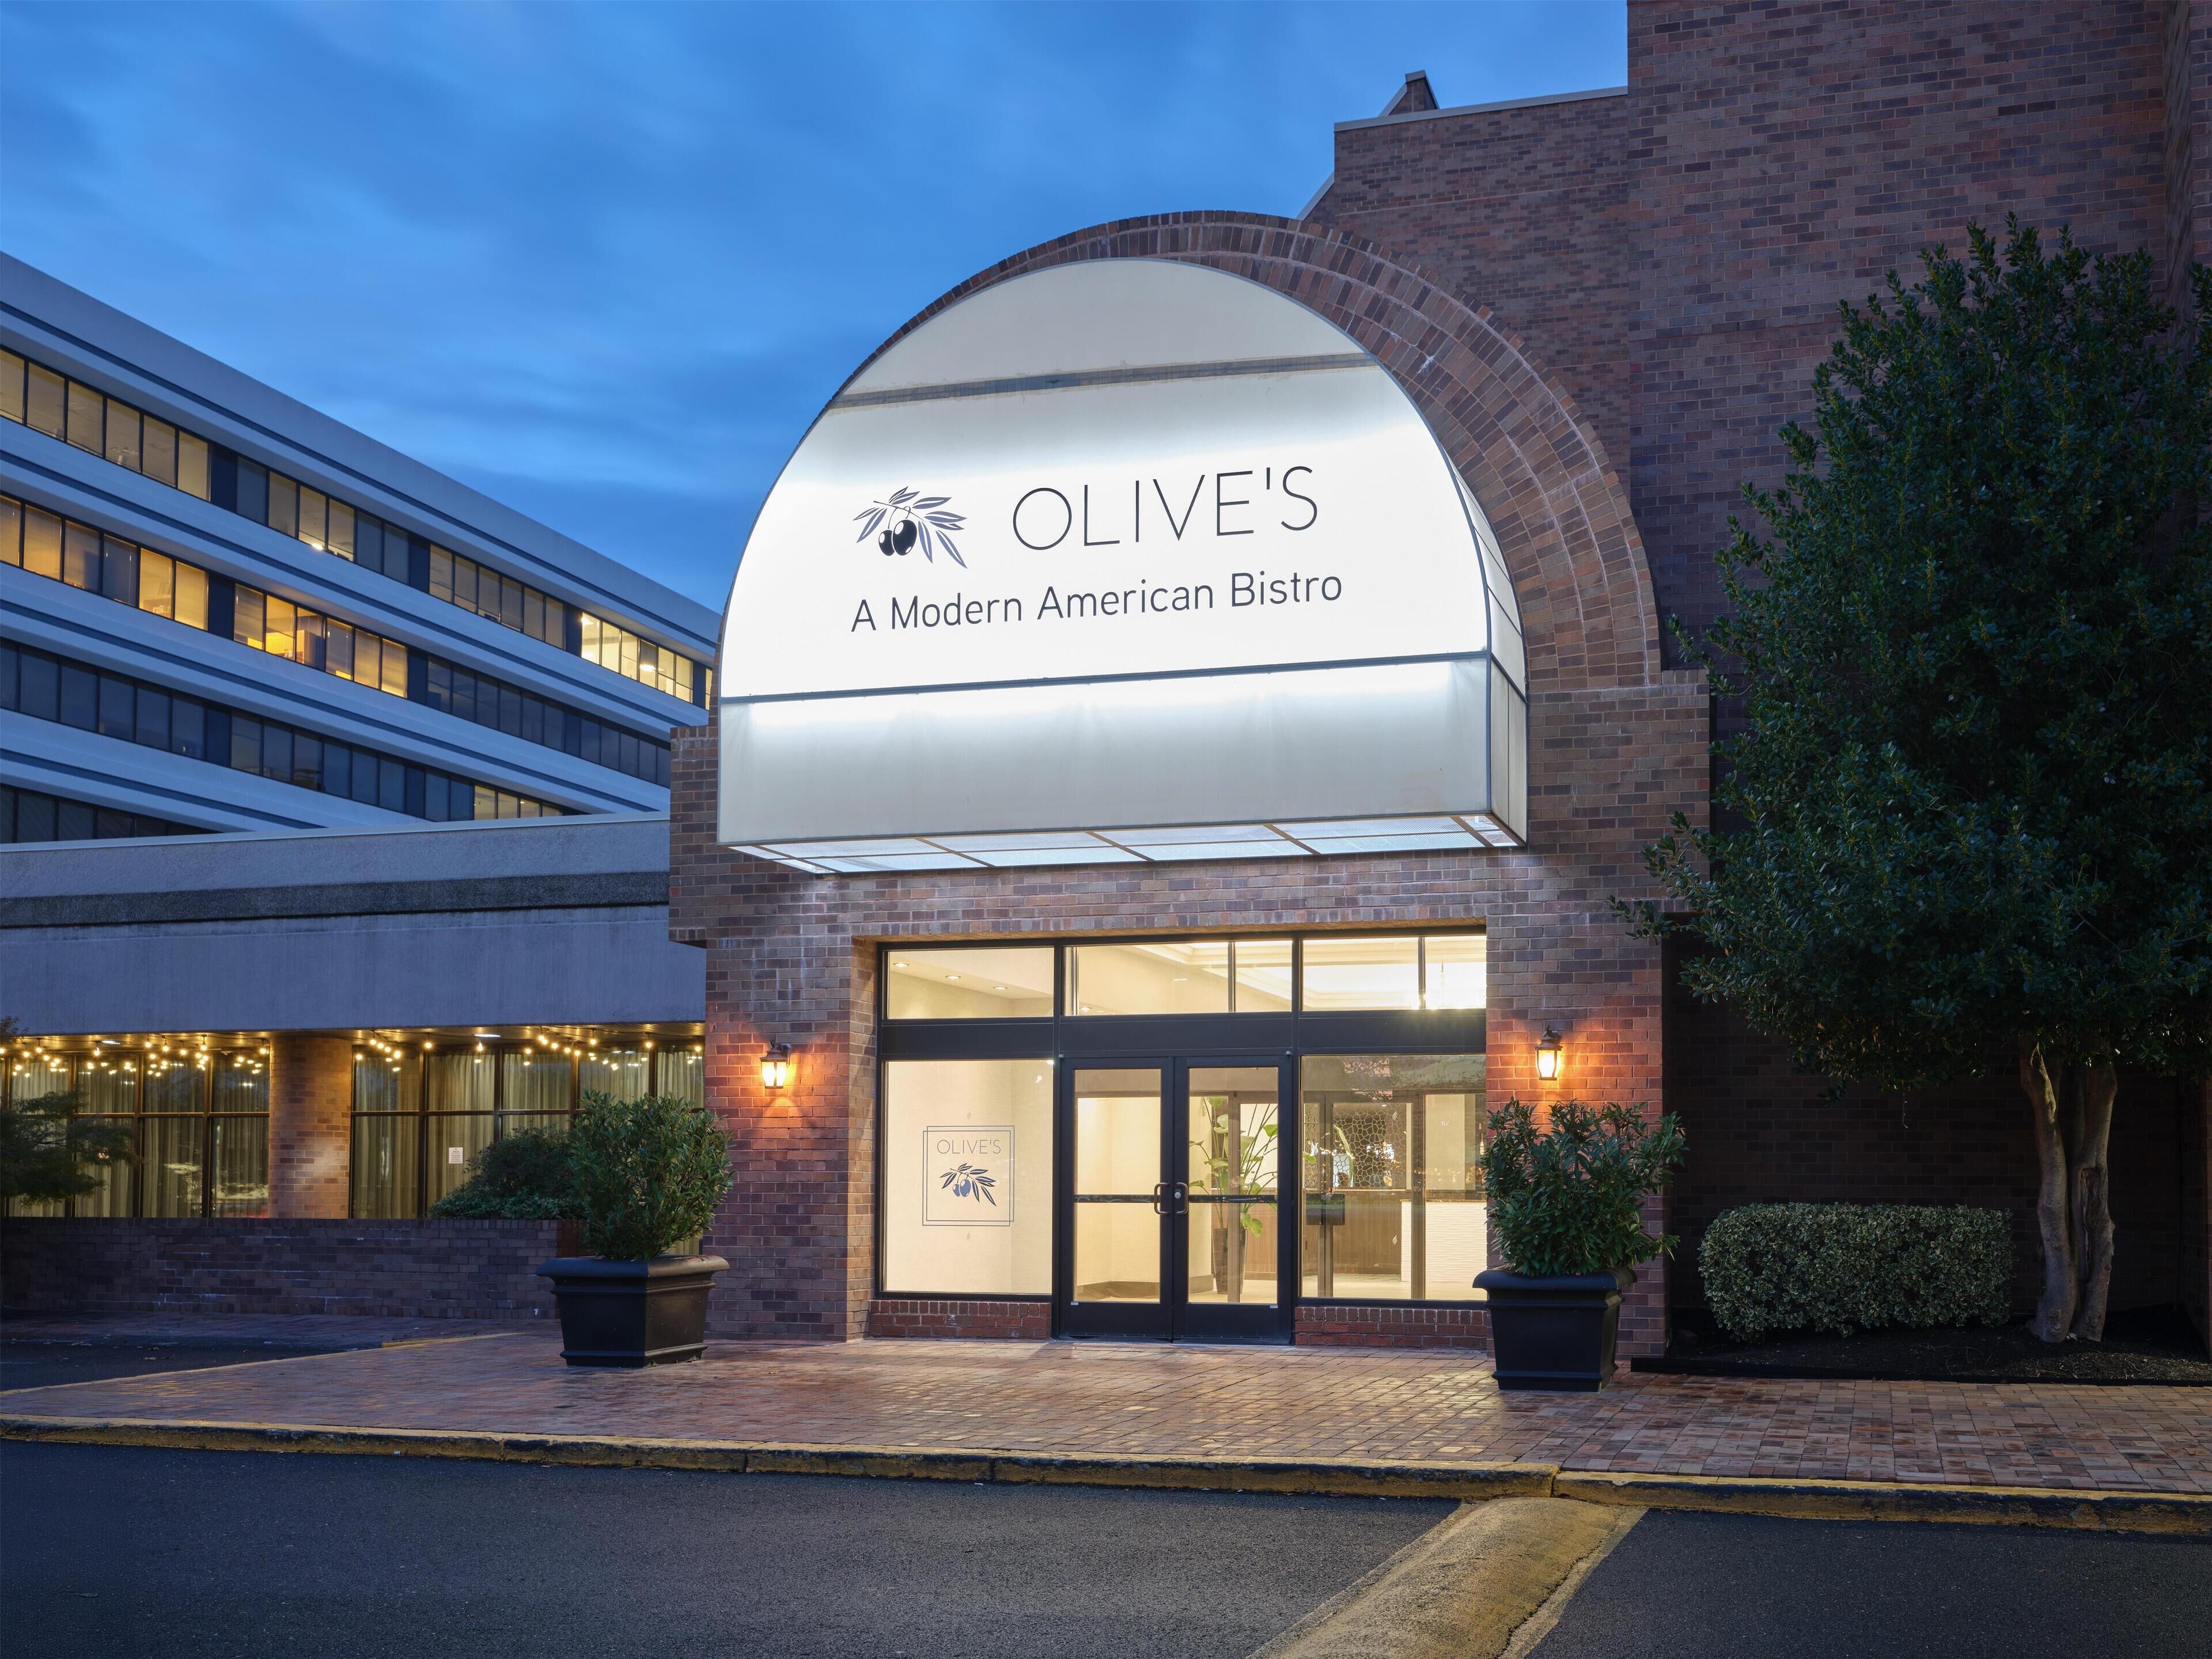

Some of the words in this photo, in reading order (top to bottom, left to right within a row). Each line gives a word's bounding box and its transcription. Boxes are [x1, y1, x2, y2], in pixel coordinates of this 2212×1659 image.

[1013, 465, 1318, 551] OLIVE'S
[851, 599, 877, 632] A
[891, 592, 1022, 630] Modern
[1037, 579, 1214, 620] American
[1231, 570, 1342, 607] Bistro
[937, 1139, 1001, 1154] OLIVE'S
